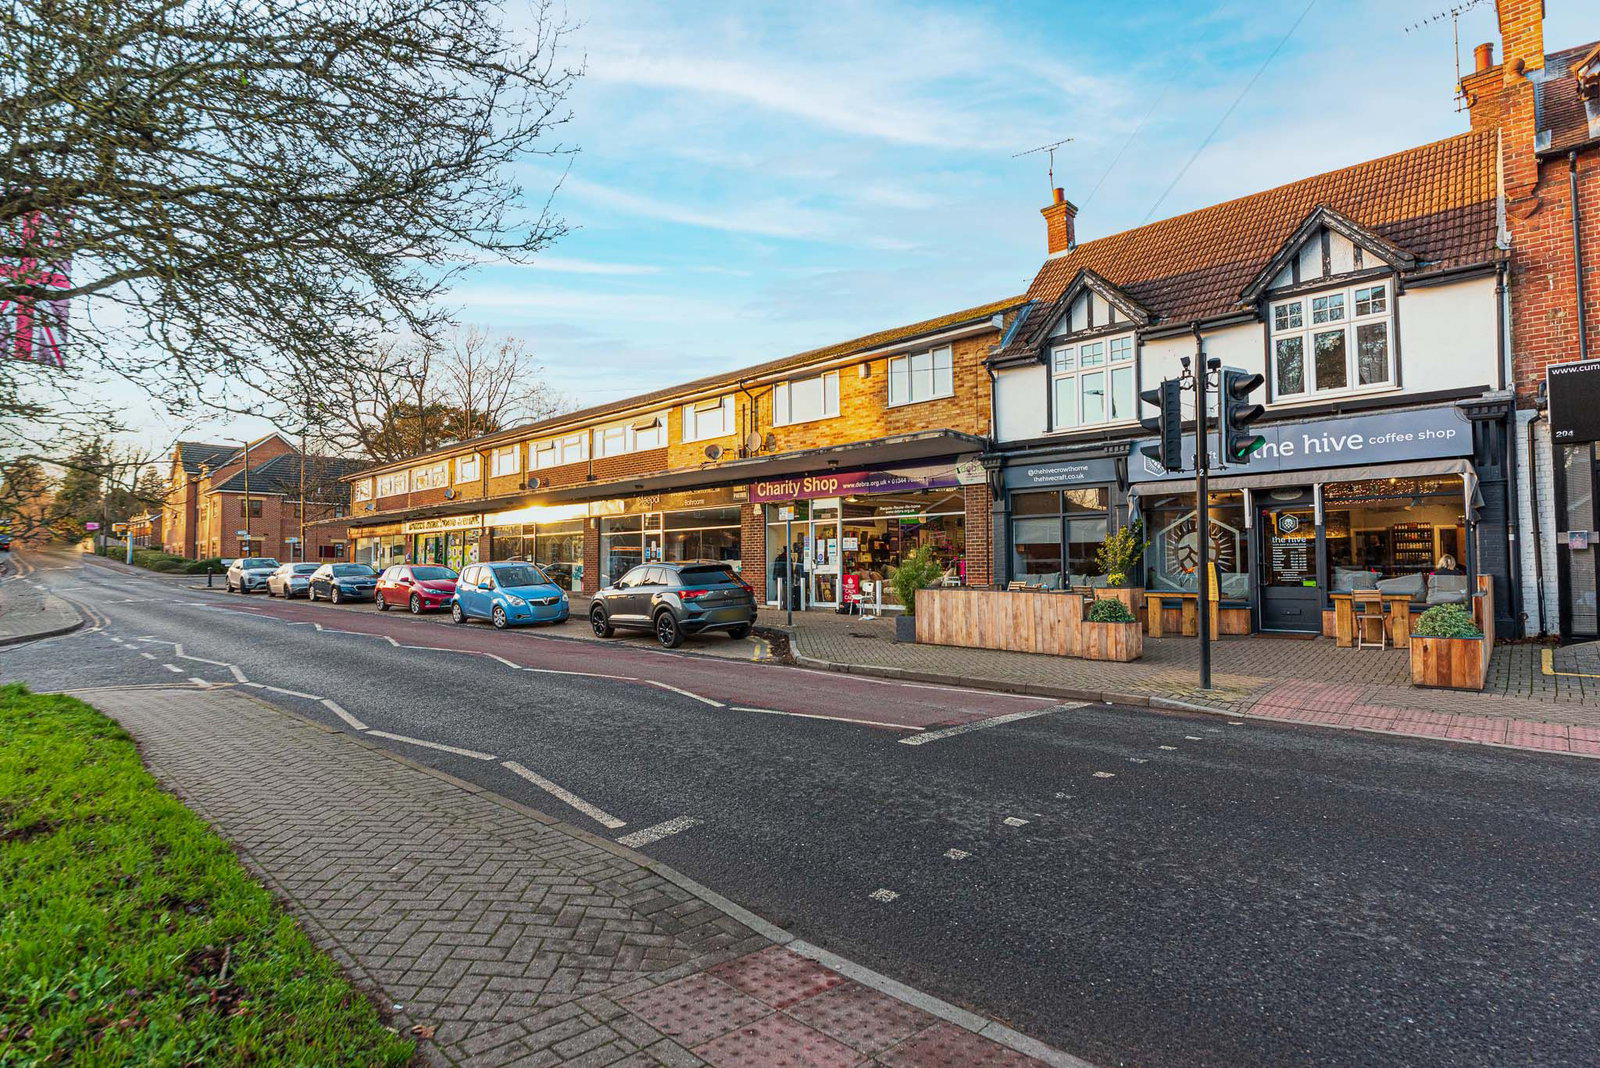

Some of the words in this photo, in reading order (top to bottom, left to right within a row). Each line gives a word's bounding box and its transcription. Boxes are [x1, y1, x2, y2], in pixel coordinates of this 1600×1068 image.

[1555, 430, 1574, 438] 204
[1302, 432, 1364, 454] hive
[1368, 432, 1414, 445] coffee
[1418, 428, 1456, 440] shop
[1027, 464, 1089, 477] @thehivecrowthorne
[1199, 468, 1205, 476] 2
[1033, 472, 1085, 483] thehivecraft.co.uk
[757, 480, 801, 498] Charity
[803, 477, 838, 494] Shop
[842, 478, 887, 489] www.debra.org.uk
